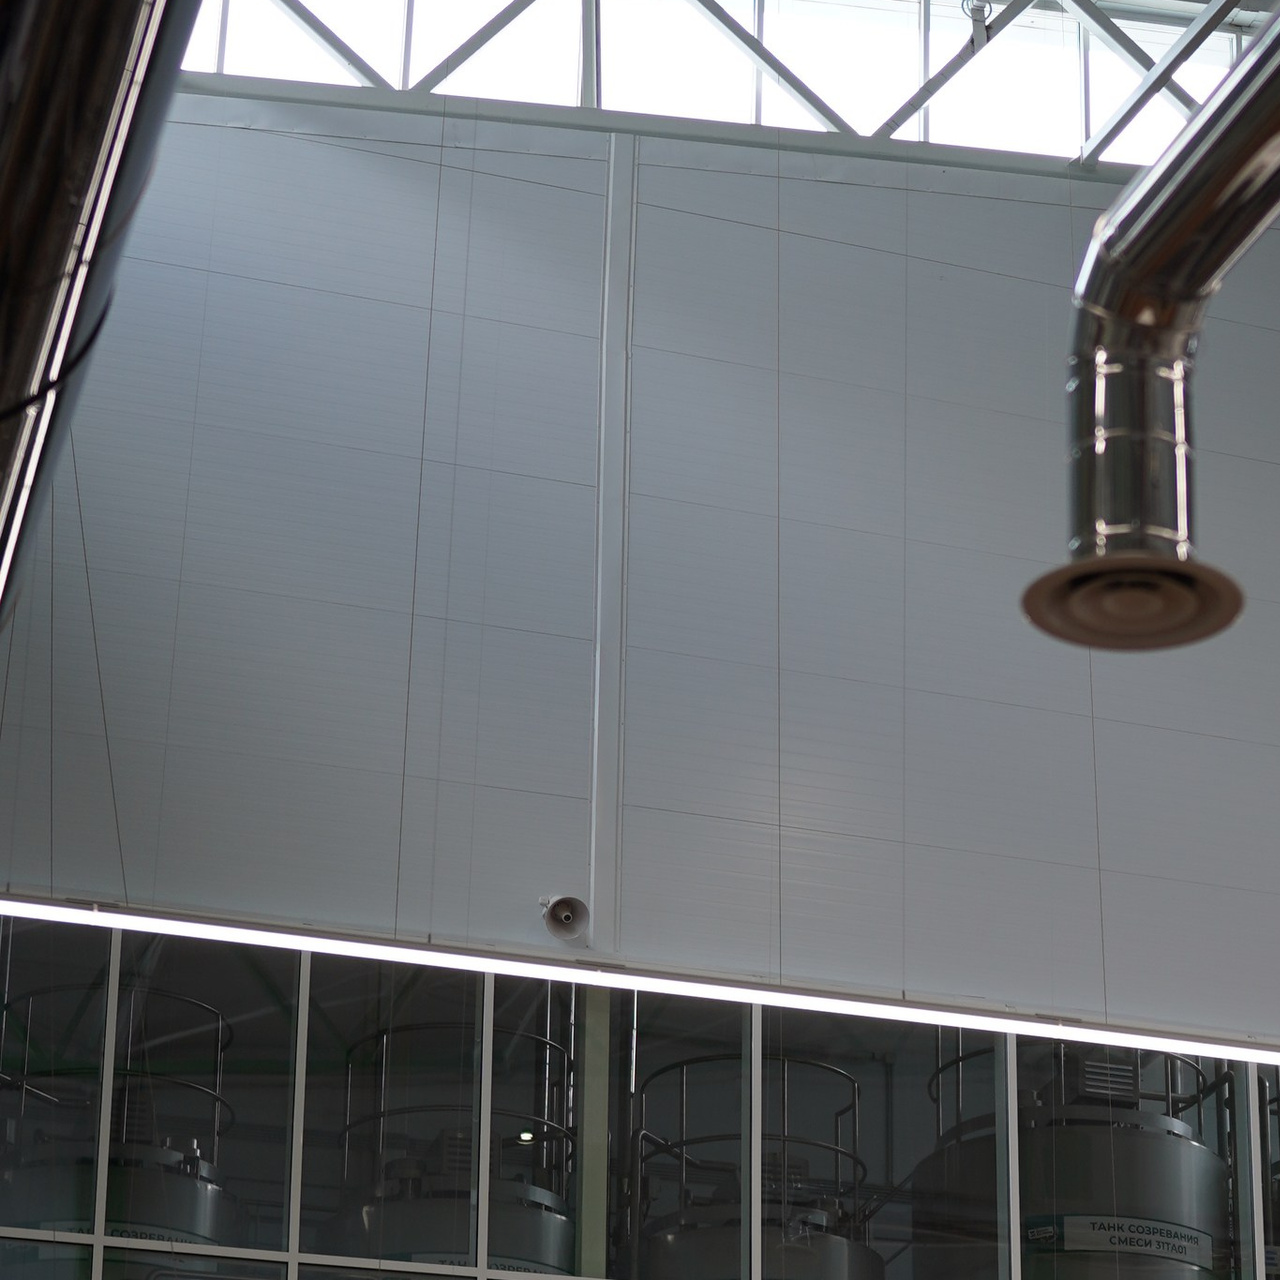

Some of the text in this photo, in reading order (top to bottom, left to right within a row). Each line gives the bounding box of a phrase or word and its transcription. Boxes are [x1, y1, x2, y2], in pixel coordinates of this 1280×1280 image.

[1090, 1222, 1199, 1246] ТАНК СОЗРЕВАНИЯ
[1109, 1236, 1152, 1249] СМЕСИ
